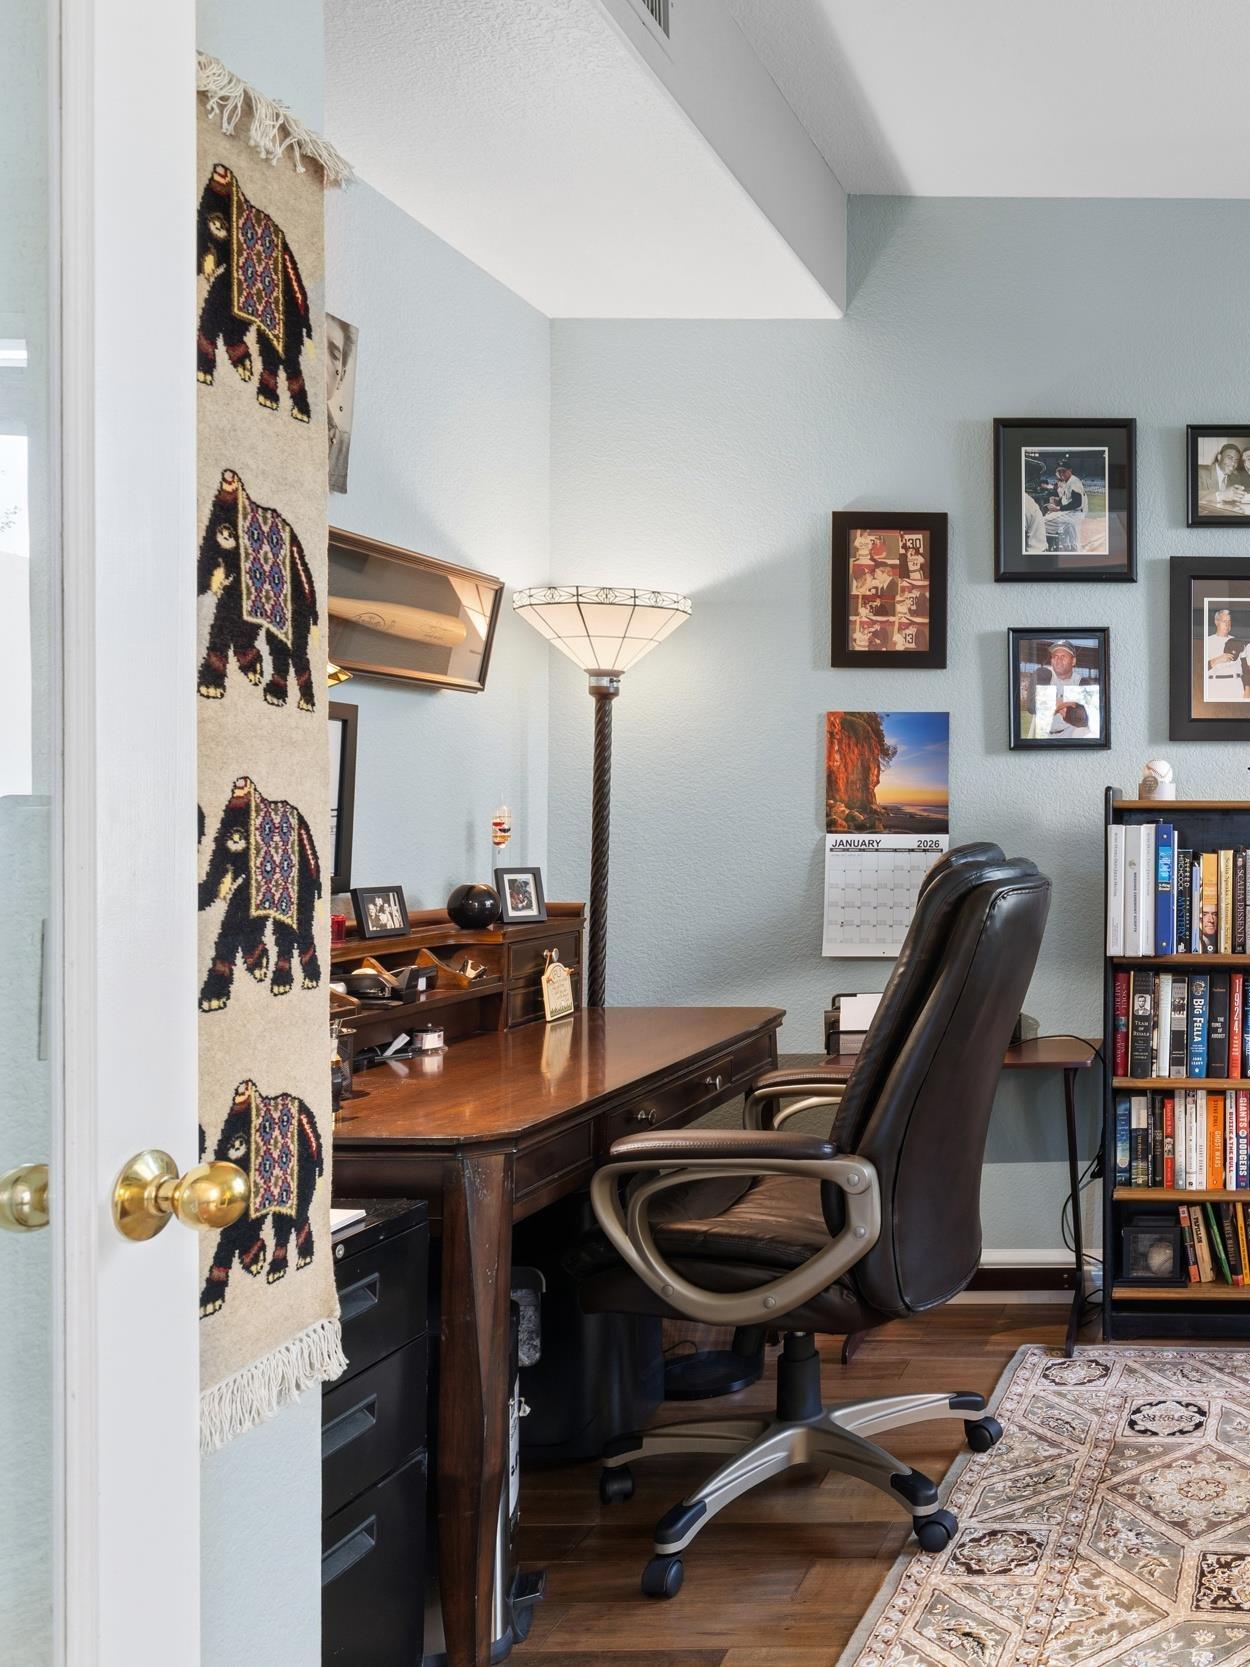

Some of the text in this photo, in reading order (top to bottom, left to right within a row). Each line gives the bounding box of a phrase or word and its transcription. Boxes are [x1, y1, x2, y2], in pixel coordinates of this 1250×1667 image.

[832, 839, 939, 848] JANUARY 2026
[1193, 999, 1204, 1041] BIG FELLA
[1239, 1138, 1247, 1176] DODGERS
[1193, 1217, 1202, 1243] PAPILLON
[1224, 1220, 1236, 1264] JAMES MADISON
